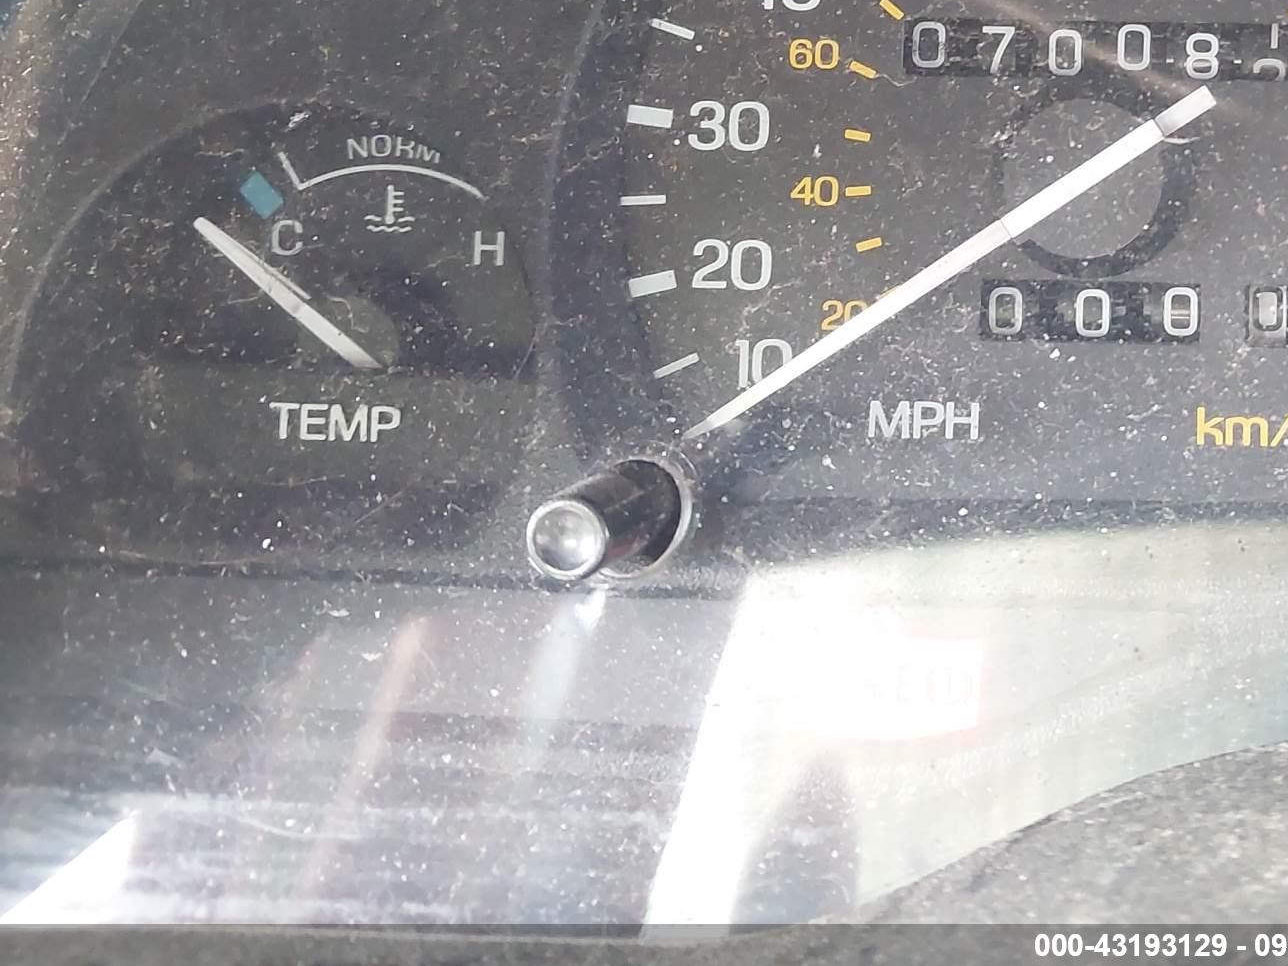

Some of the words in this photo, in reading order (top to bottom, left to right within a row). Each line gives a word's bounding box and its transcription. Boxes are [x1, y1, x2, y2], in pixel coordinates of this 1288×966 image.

[788, 39, 840, 70] 60
[687, 100, 770, 151] 30
[346, 134, 441, 164] NORM
[790, 176, 839, 207] 40
[271, 220, 304, 256] C
[473, 231, 505, 266] H
[692, 238, 773, 290] 20
[820, 299, 868, 331] 20
[735, 337, 794, 389] 10
[271, 401, 401, 442] TEMP
[867, 400, 980, 440] MPH
